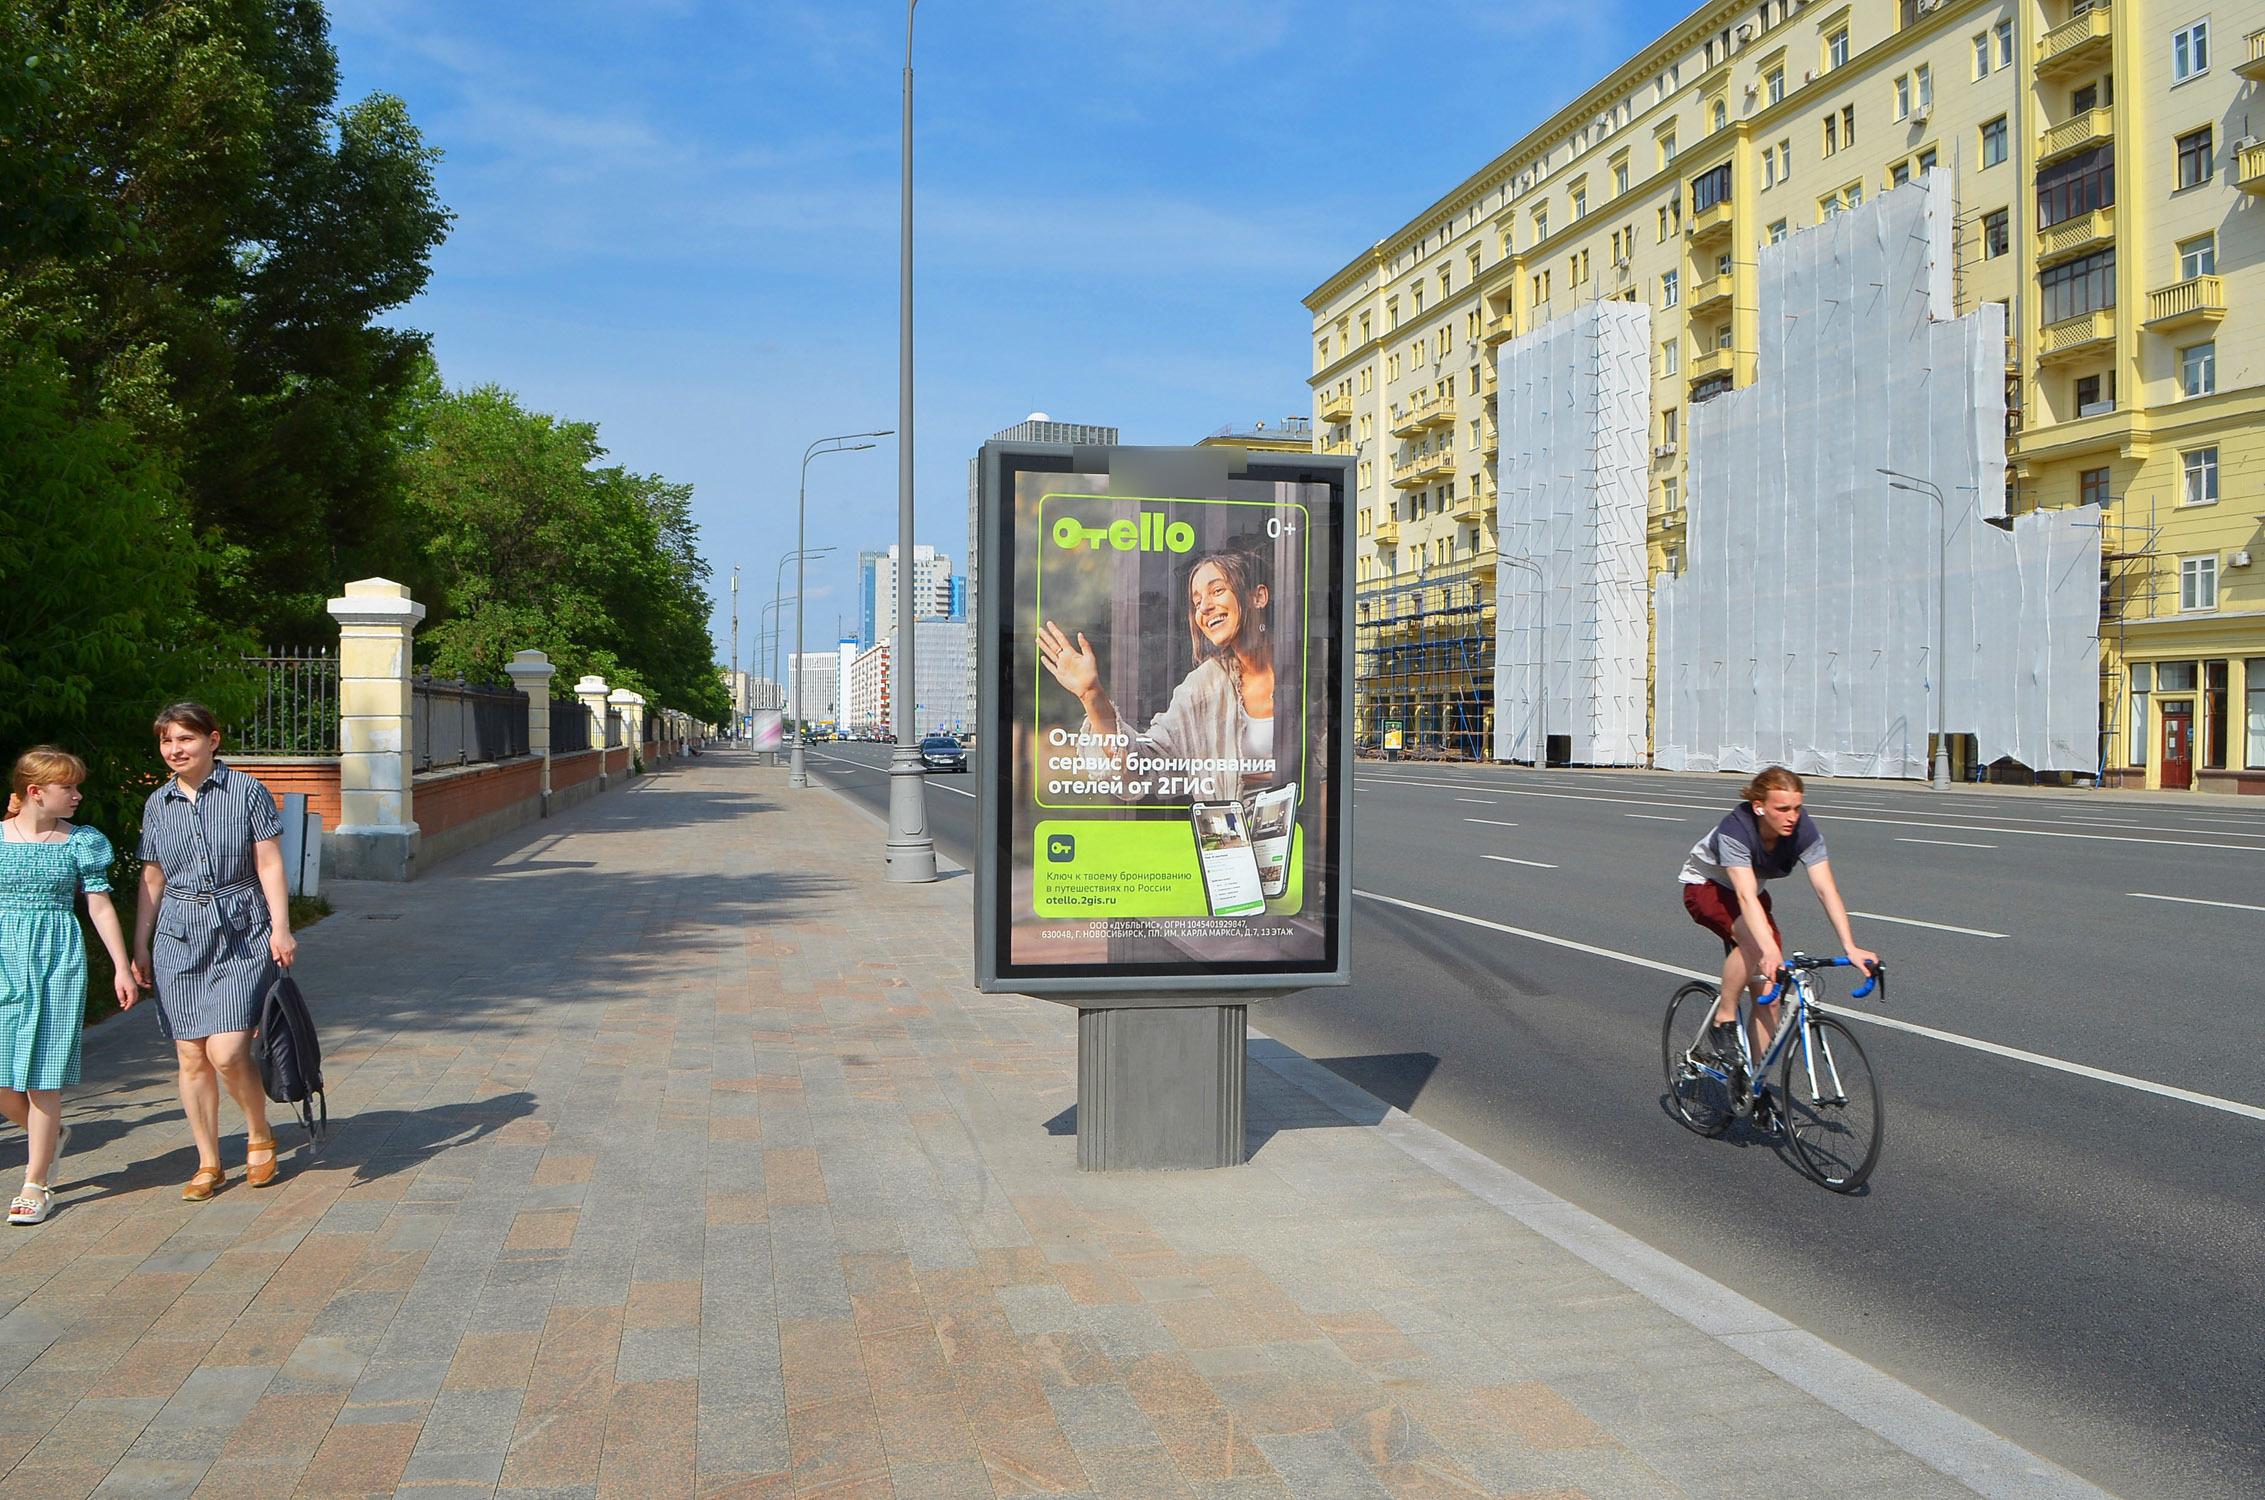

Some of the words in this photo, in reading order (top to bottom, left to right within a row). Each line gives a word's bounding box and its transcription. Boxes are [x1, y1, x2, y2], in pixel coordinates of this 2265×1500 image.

[1266, 517, 1296, 539] 0+
[1048, 728, 1130, 748] Отелло
[1048, 755, 1122, 775] сервис
[1126, 751, 1277, 774] бронирования
[1048, 776, 1123, 795] отелей
[1128, 780, 1153, 795] от
[1157, 776, 1217, 796] 2ГИС
[1046, 872, 1073, 881] Ключ
[1084, 874, 1118, 882] твоему
[1120, 871, 1192, 882] бронированию
[1046, 885, 1052, 893] в
[1055, 885, 1121, 894] путешествиях
[1123, 885, 1136, 893] по
[1138, 883, 1172, 893] России
[1046, 896, 1117, 907] otello.2gis.ru
[1089, 921, 1109, 930] ООО
[1164, 920, 1186, 930] ОГРН
[1041, 930, 1074, 940] 630048,
[1075, 930, 1082, 939] Г.
[1083, 929, 1147, 939] НОВОСИБИРСК,
[1148, 929, 1163, 939] ПЛ.
[1164, 928, 1180, 938] ИМ.
[1181, 928, 1208, 938] КАРЛА
[1208, 927, 1244, 938] МАРКСА,
[1261, 927, 1271, 936] 13
[1271, 927, 1294, 937] ЭТАЖ
